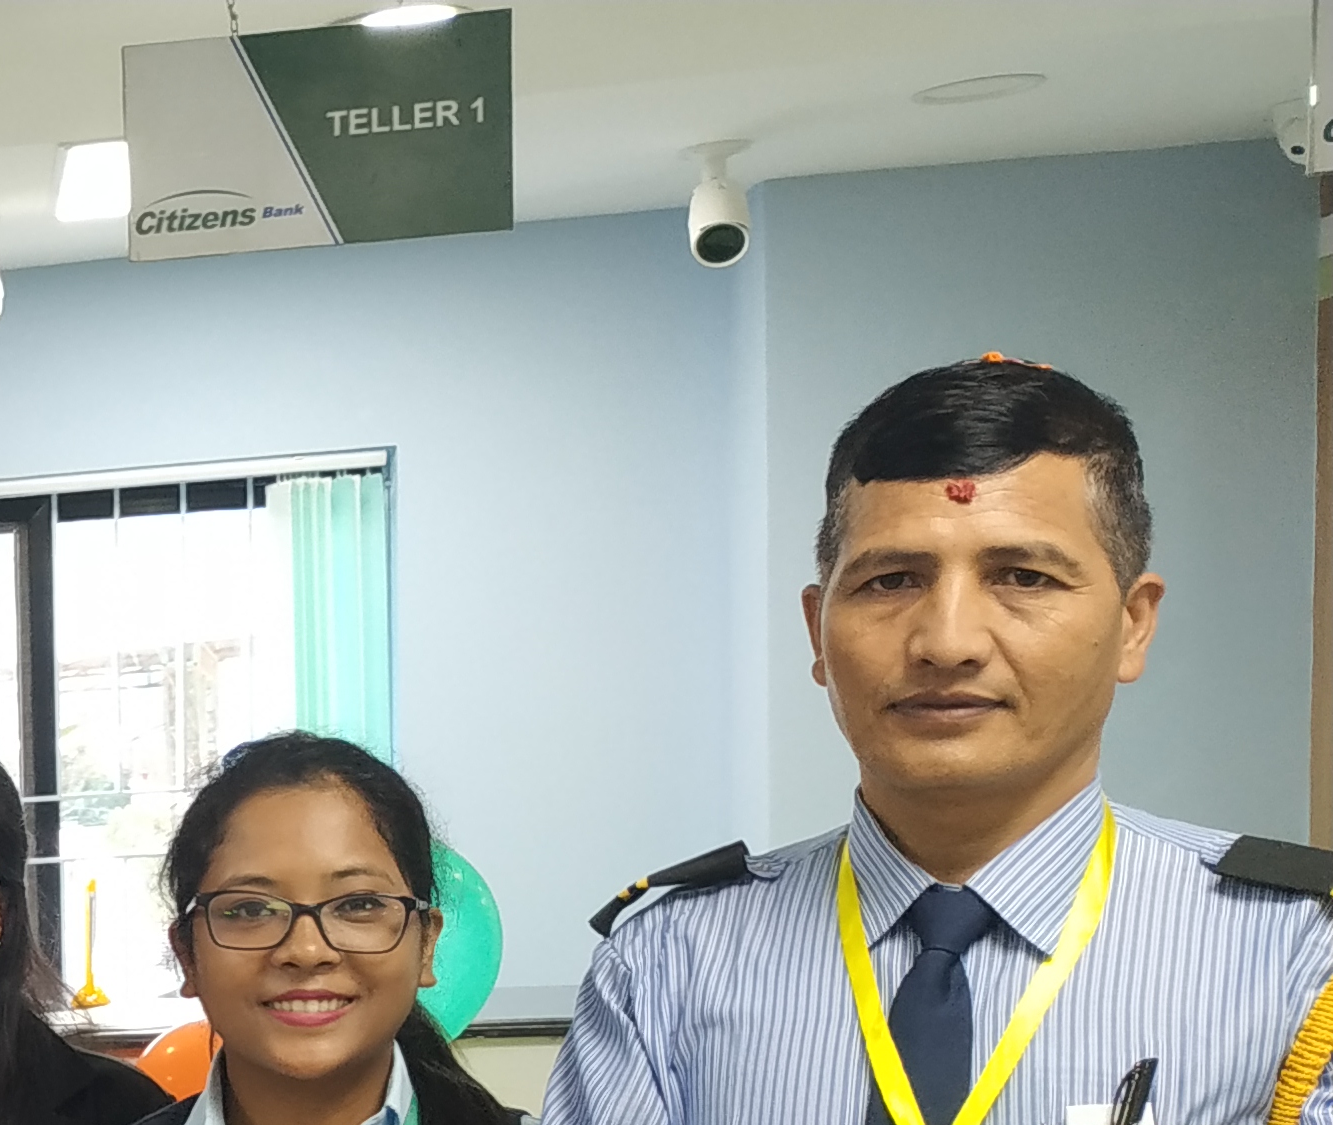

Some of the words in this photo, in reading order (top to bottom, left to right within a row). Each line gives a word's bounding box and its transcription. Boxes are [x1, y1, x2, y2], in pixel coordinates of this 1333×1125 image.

[325, 99, 460, 137] TELLER
[470, 97, 485, 123] 1
[135, 204, 256, 236] Citizens
[262, 203, 304, 219] Bank
